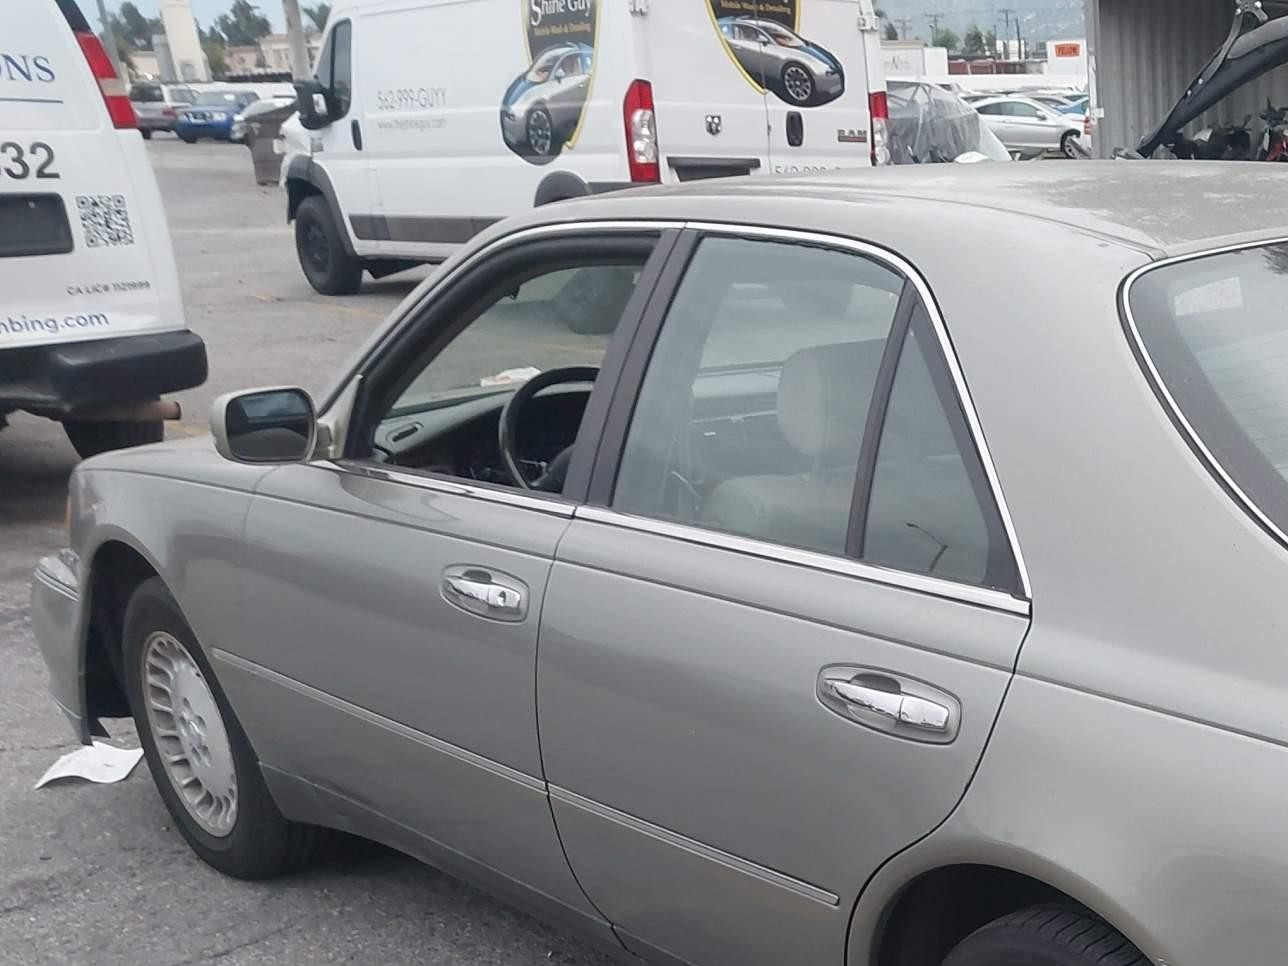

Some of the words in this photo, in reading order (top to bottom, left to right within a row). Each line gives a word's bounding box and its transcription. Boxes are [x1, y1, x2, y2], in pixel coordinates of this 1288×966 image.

[531, 0, 565, 26] Shine
[567, 0, 592, 17] Guy
[0, 53, 55, 83] NS
[0, 141, 60, 179] 32
